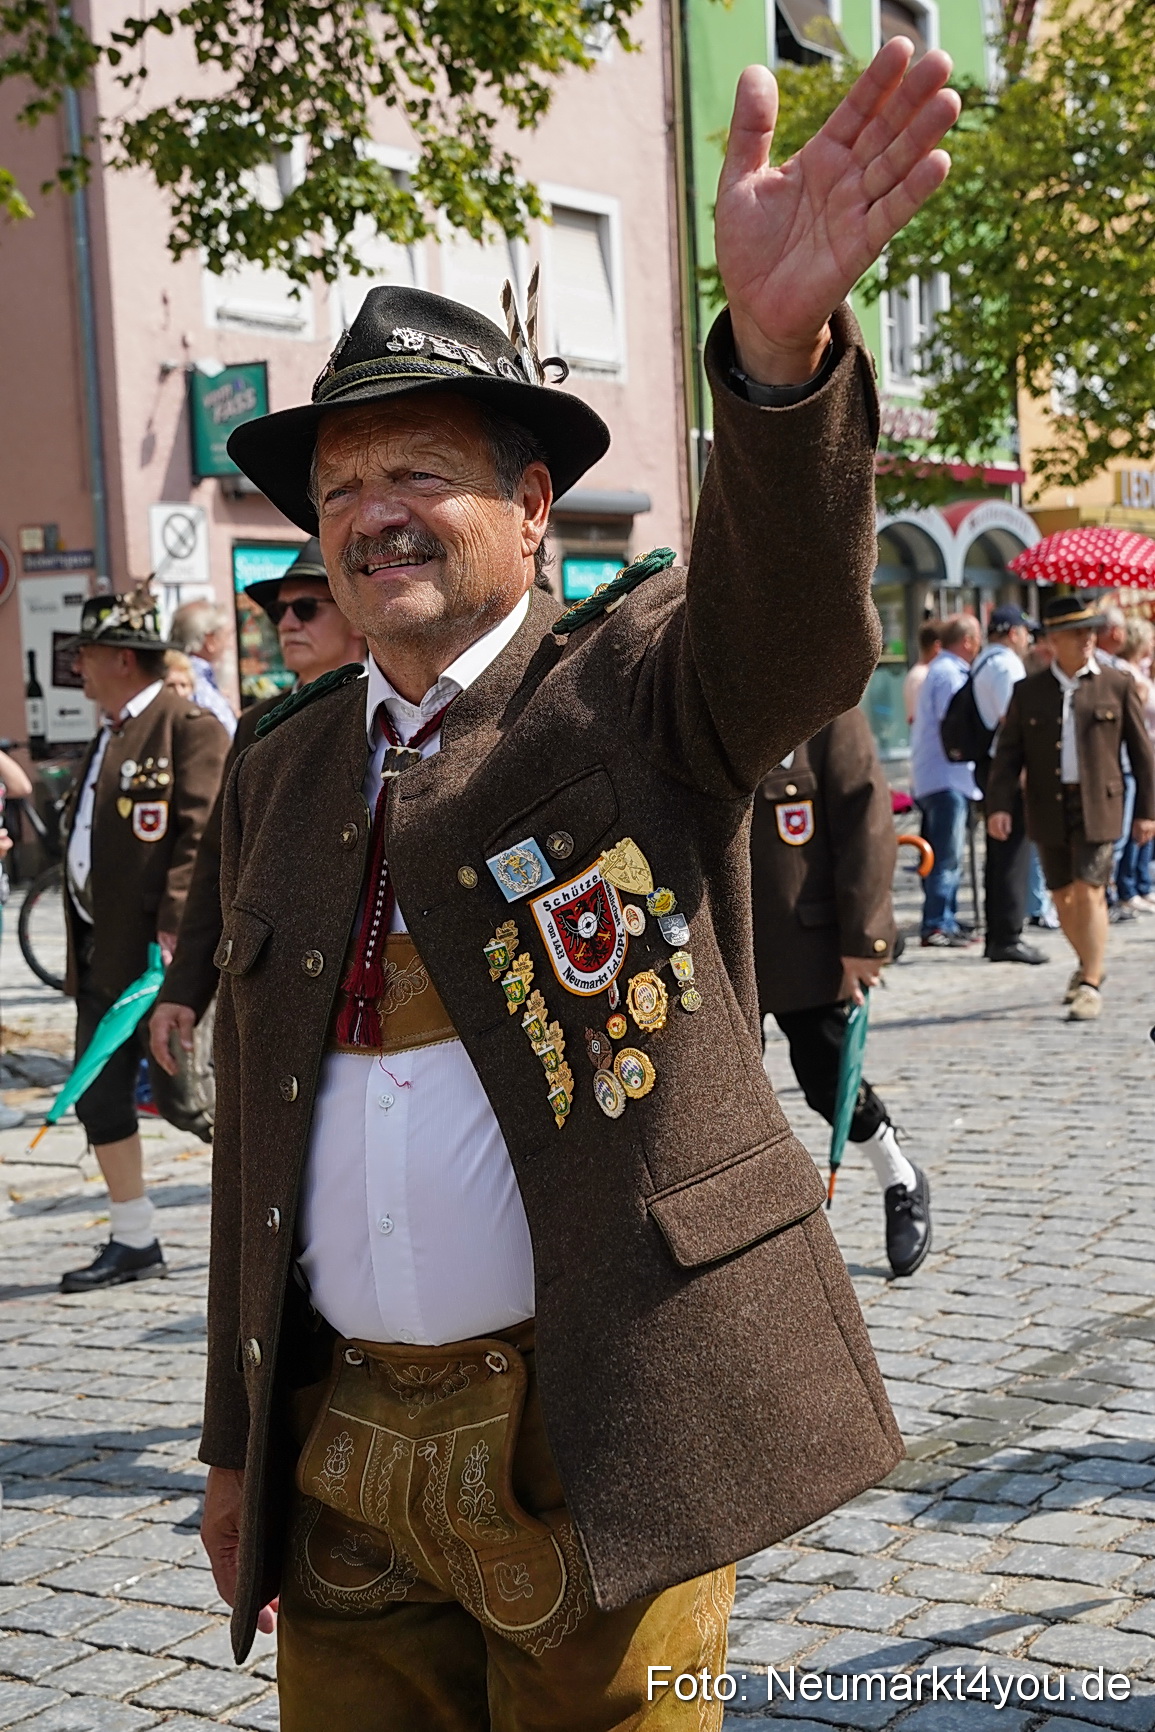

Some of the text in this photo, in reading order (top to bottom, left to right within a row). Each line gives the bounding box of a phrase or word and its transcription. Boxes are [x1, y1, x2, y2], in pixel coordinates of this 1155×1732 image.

[543, 873, 602, 912] Schütze
[546, 920, 565, 960] von 1433
[562, 965, 609, 990] Neumarkt
